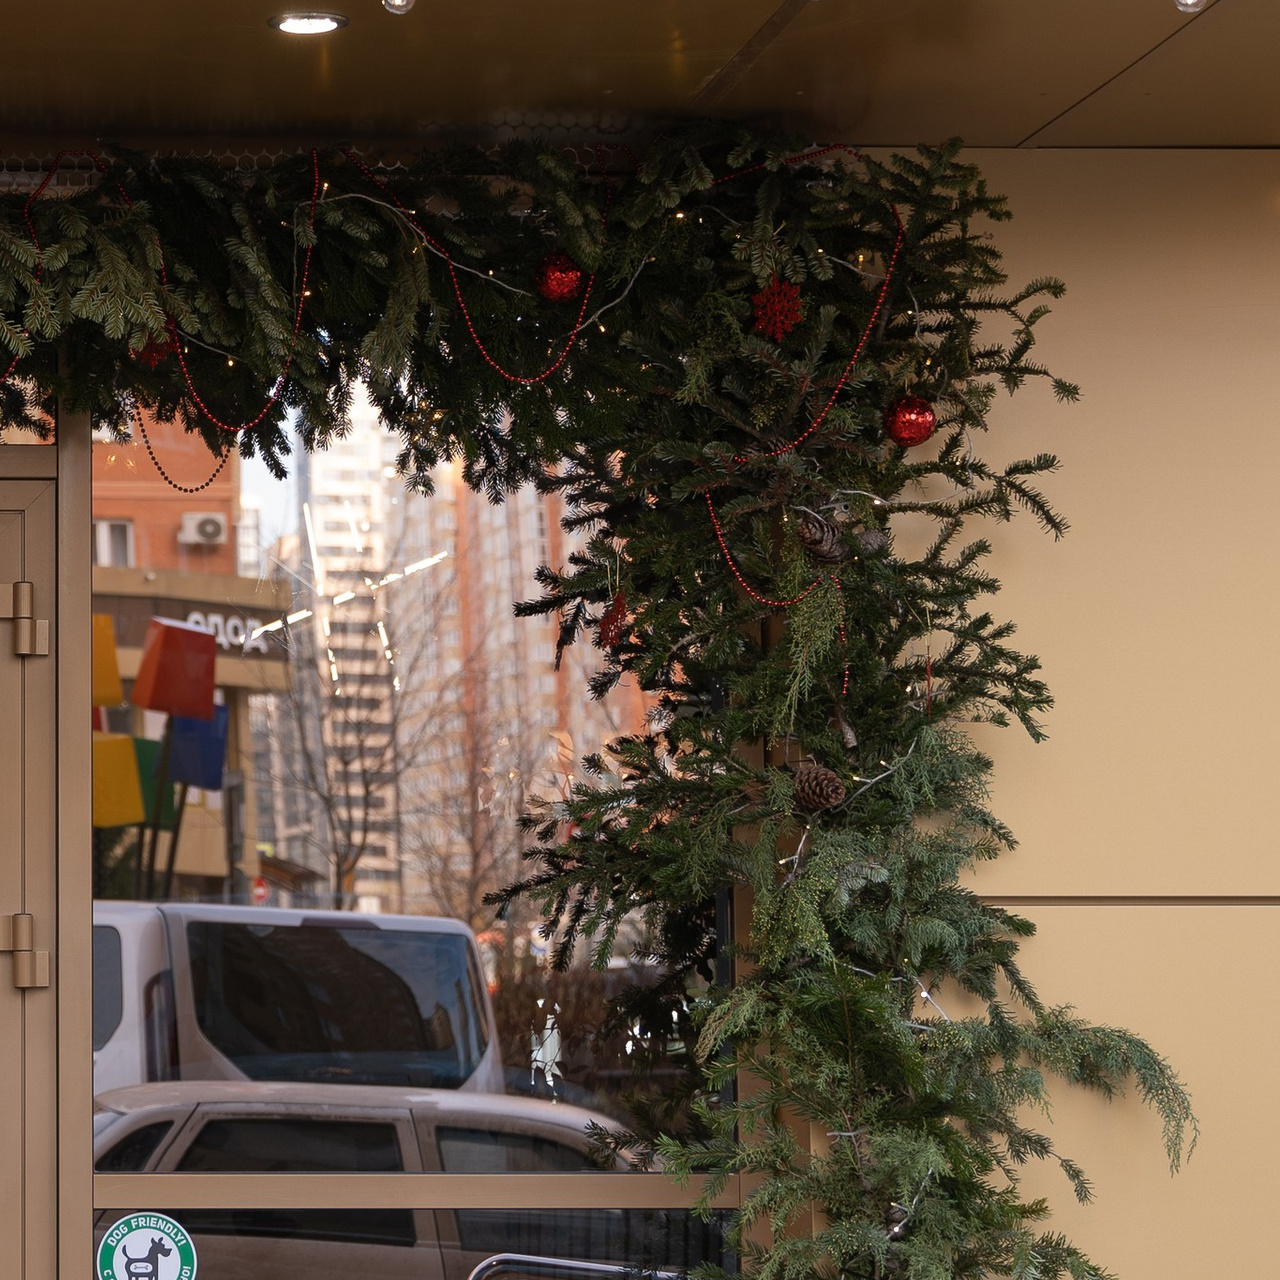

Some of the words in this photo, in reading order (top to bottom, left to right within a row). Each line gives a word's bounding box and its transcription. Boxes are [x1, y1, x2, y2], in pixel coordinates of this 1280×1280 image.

[107, 1225, 128, 1247] DOG
[131, 1217, 187, 1247] FRIENDLY!
[104, 1269, 112, 1277] С
